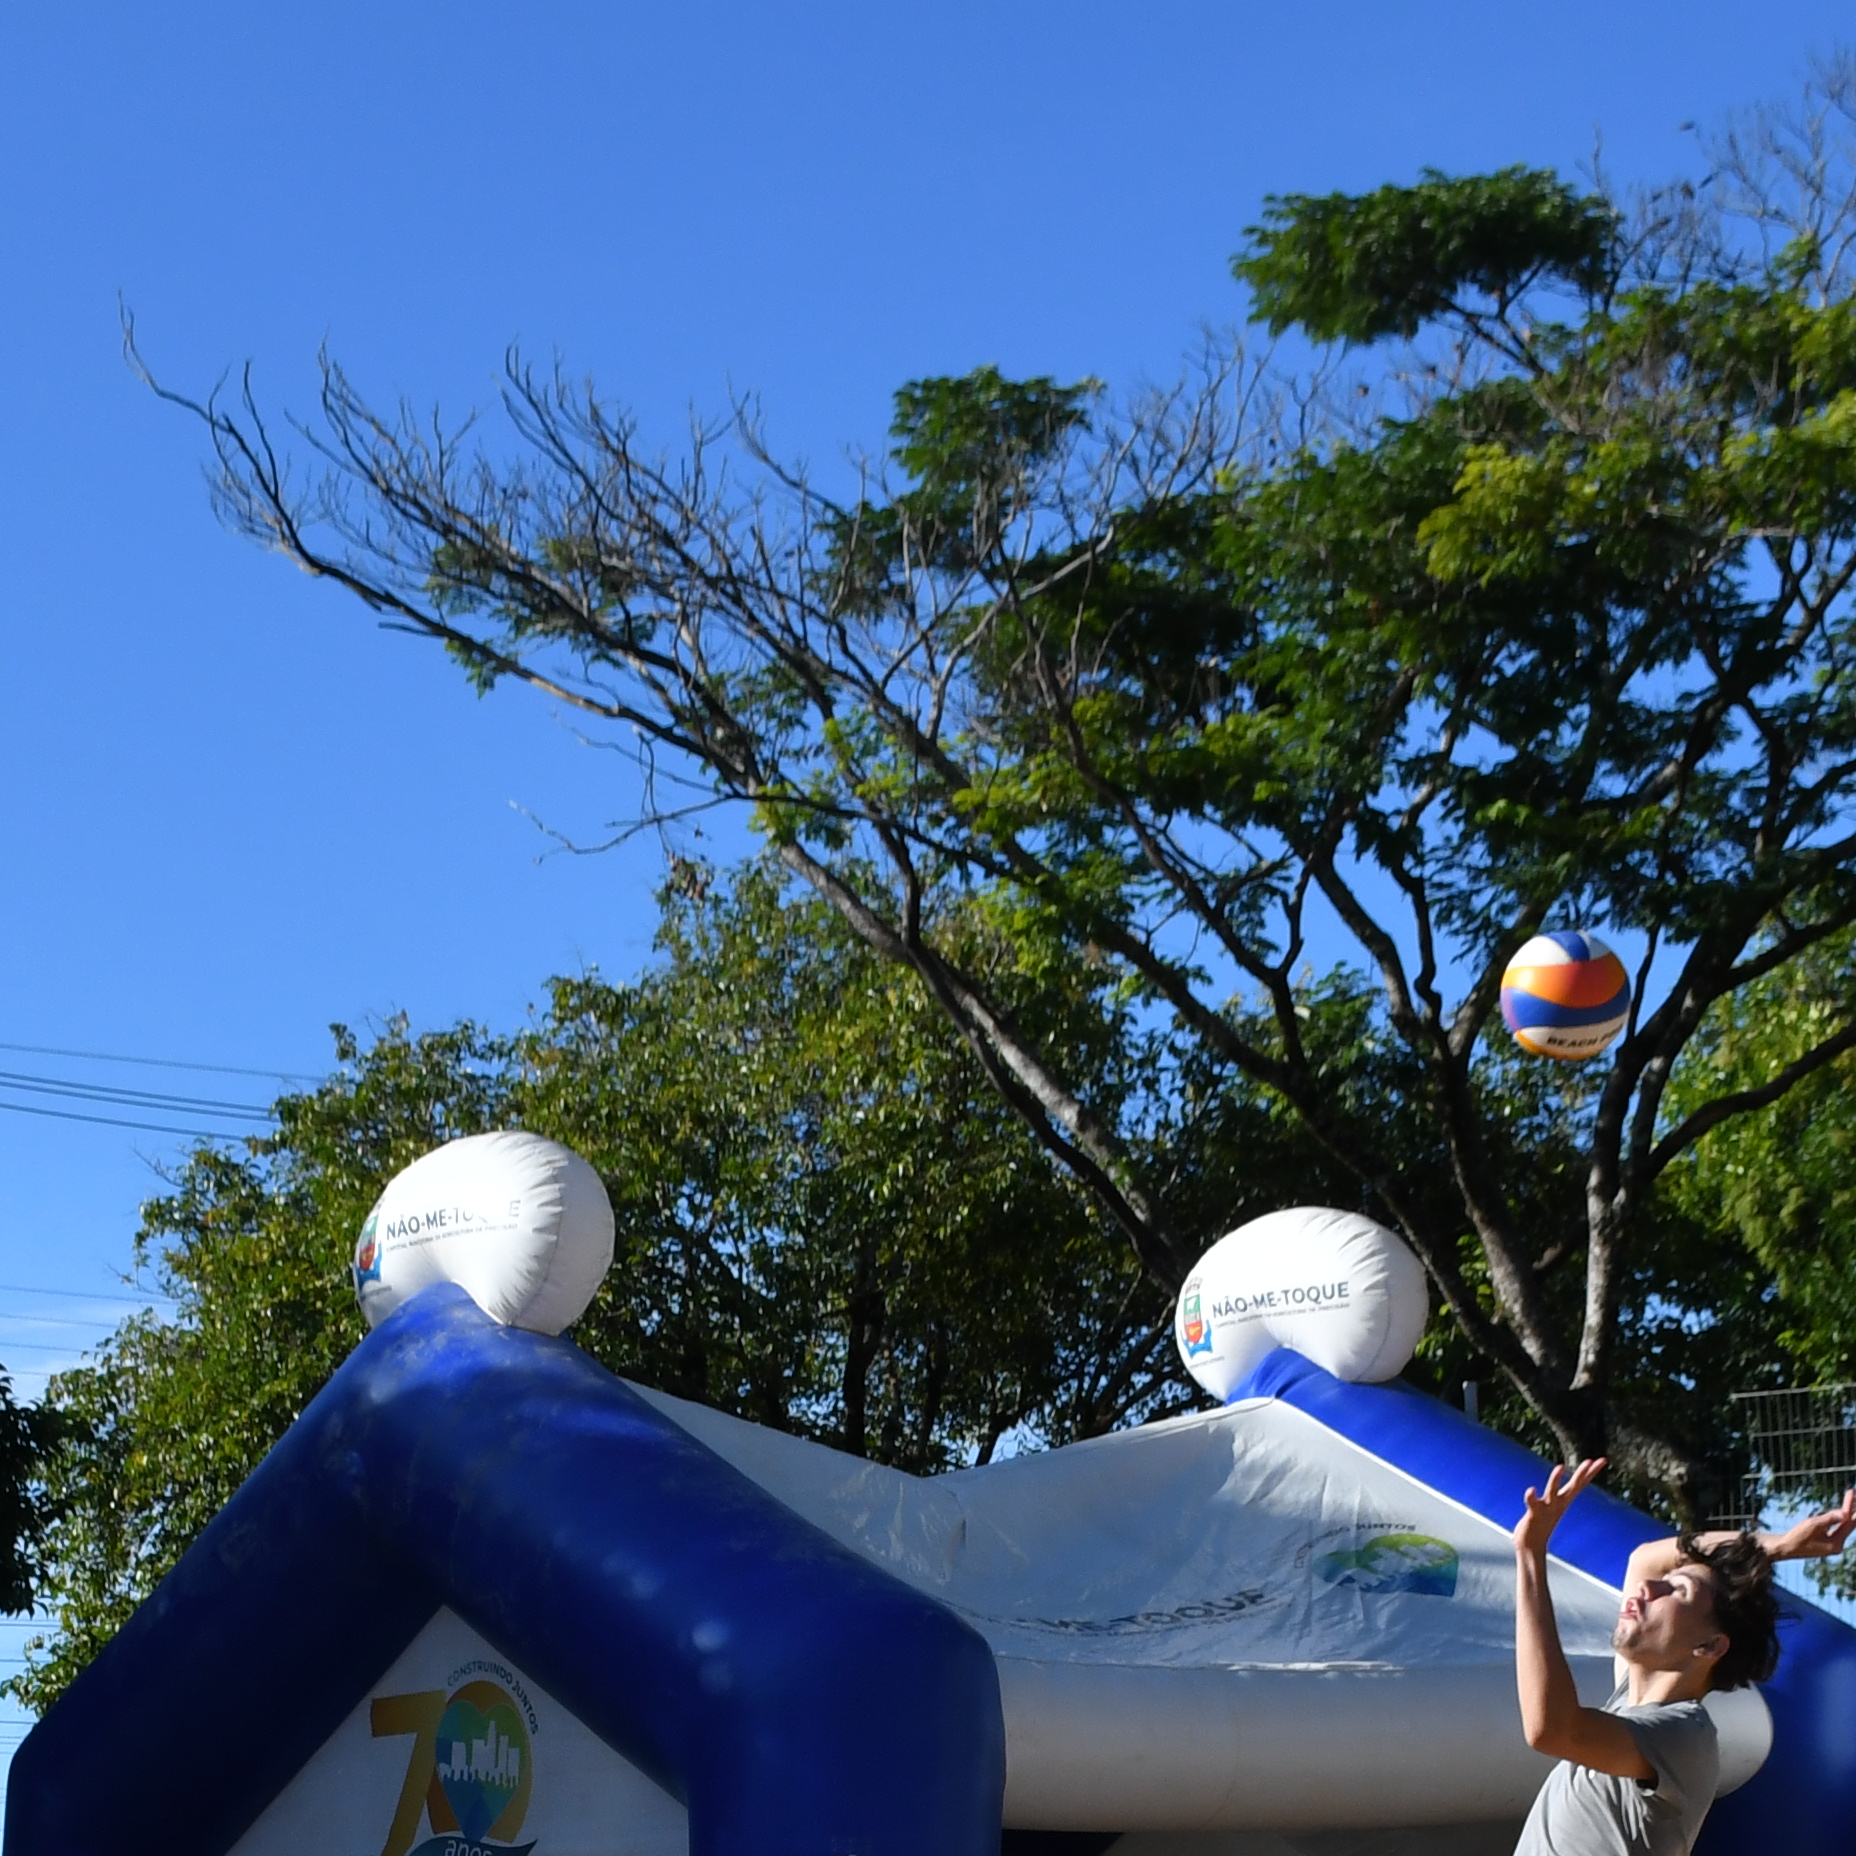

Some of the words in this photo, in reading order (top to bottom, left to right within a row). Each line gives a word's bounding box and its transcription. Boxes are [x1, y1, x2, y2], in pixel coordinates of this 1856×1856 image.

[1212, 1281, 1350, 1318] NÃO-ME-TOQUE
[447, 1660, 513, 1687] CONSTRUINDO
[512, 1680, 539, 1735] JUNTOS
